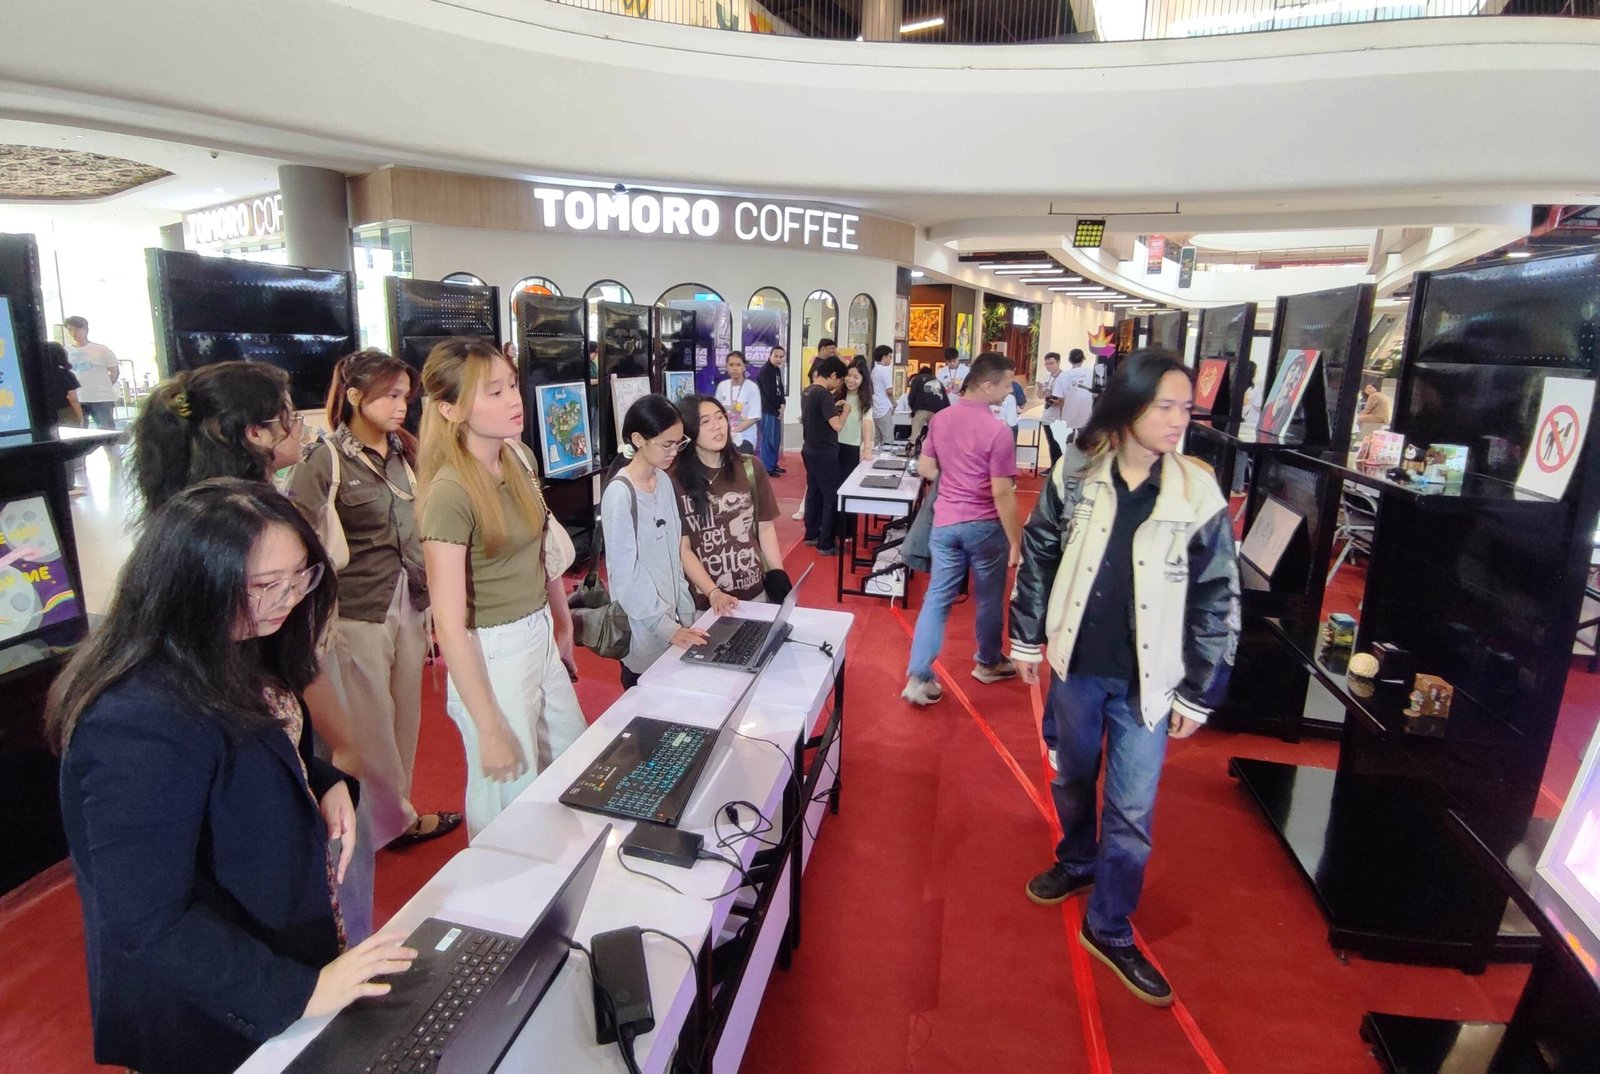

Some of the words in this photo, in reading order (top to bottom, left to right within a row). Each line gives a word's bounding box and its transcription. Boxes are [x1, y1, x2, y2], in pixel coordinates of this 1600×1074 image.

[533, 187, 719, 236] TOMORO
[735, 201, 859, 250] COFFEE
[681, 494, 695, 515] It
[703, 524, 727, 553] get
